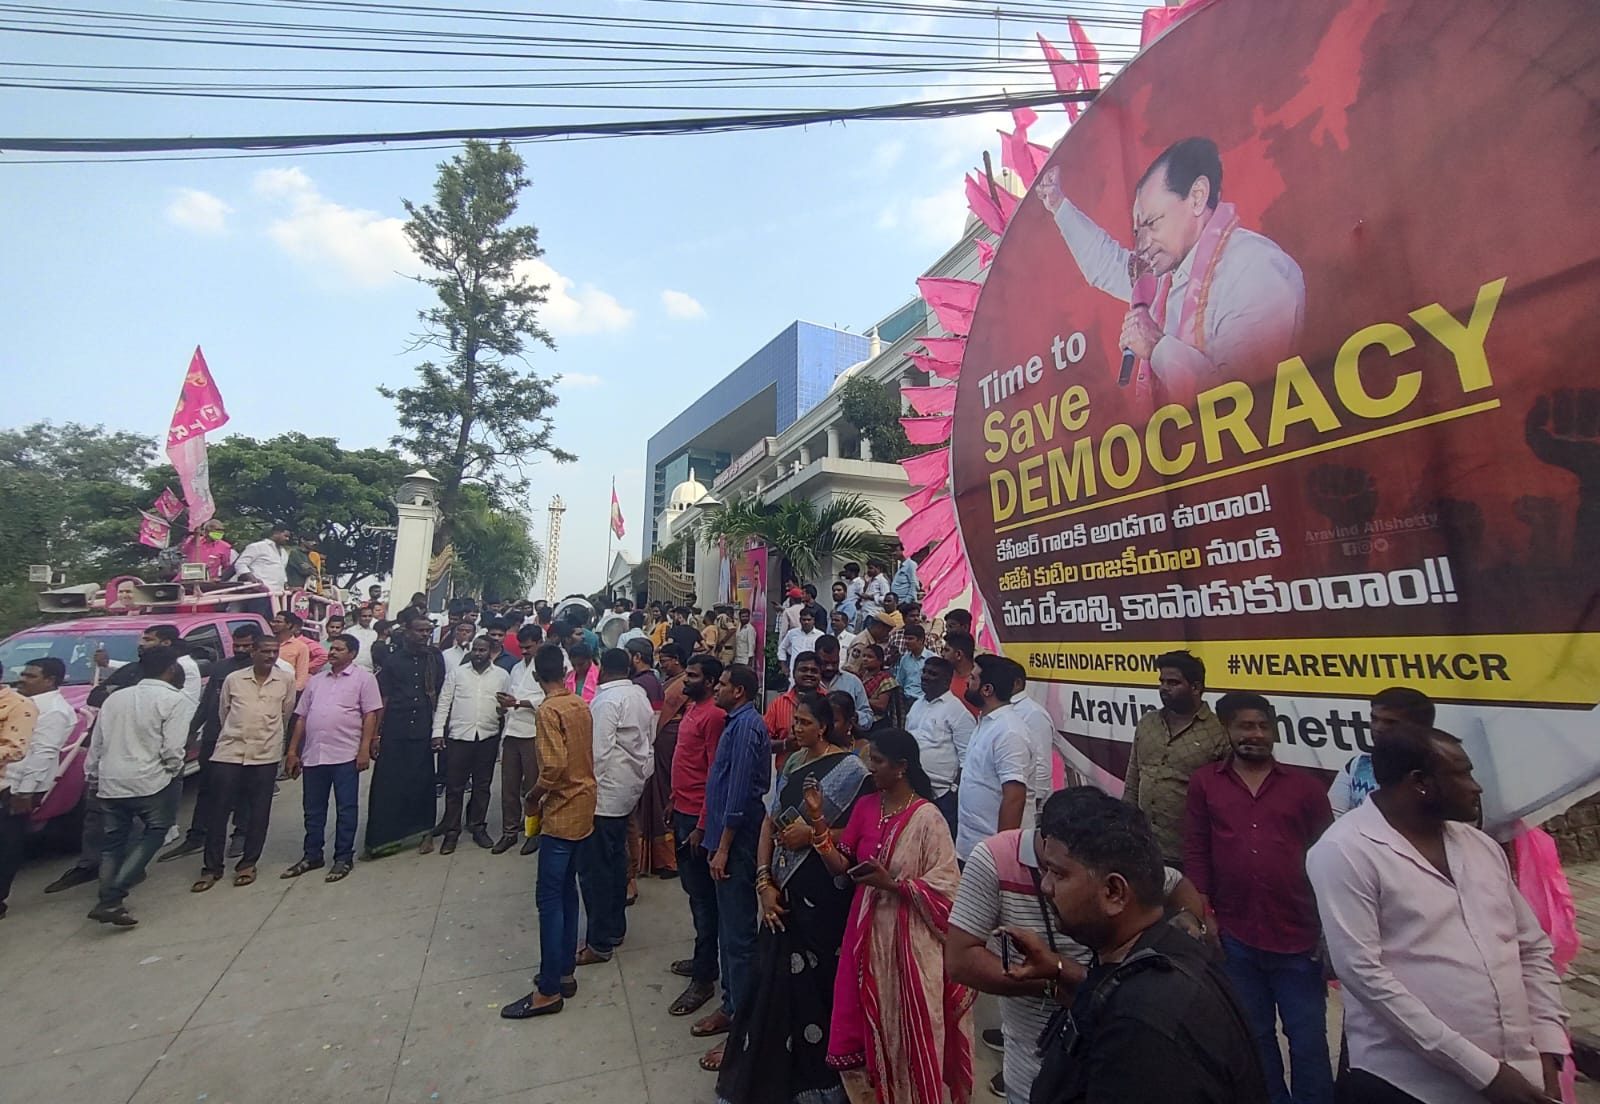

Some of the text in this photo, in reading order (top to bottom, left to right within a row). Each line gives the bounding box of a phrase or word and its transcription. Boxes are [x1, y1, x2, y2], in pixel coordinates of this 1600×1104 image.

[978, 331, 1087, 409] Time to
[989, 276, 1507, 523] DEMOCRACY
[983, 384, 1091, 463] Save
[996, 484, 1272, 562] కేసీఆర్ గారికి అండగా ఉందాం!
[998, 527, 1282, 592] బీజేపీ కుటిల రాజకీయాల నుండి
[1001, 556, 1458, 631] మన దేశాన్ని కాపాడుకుందాం!!
[1029, 652, 1512, 681] #SAVEINDIAFROM #WEAREWITHKCR
[1070, 690, 1157, 727] Aravi
